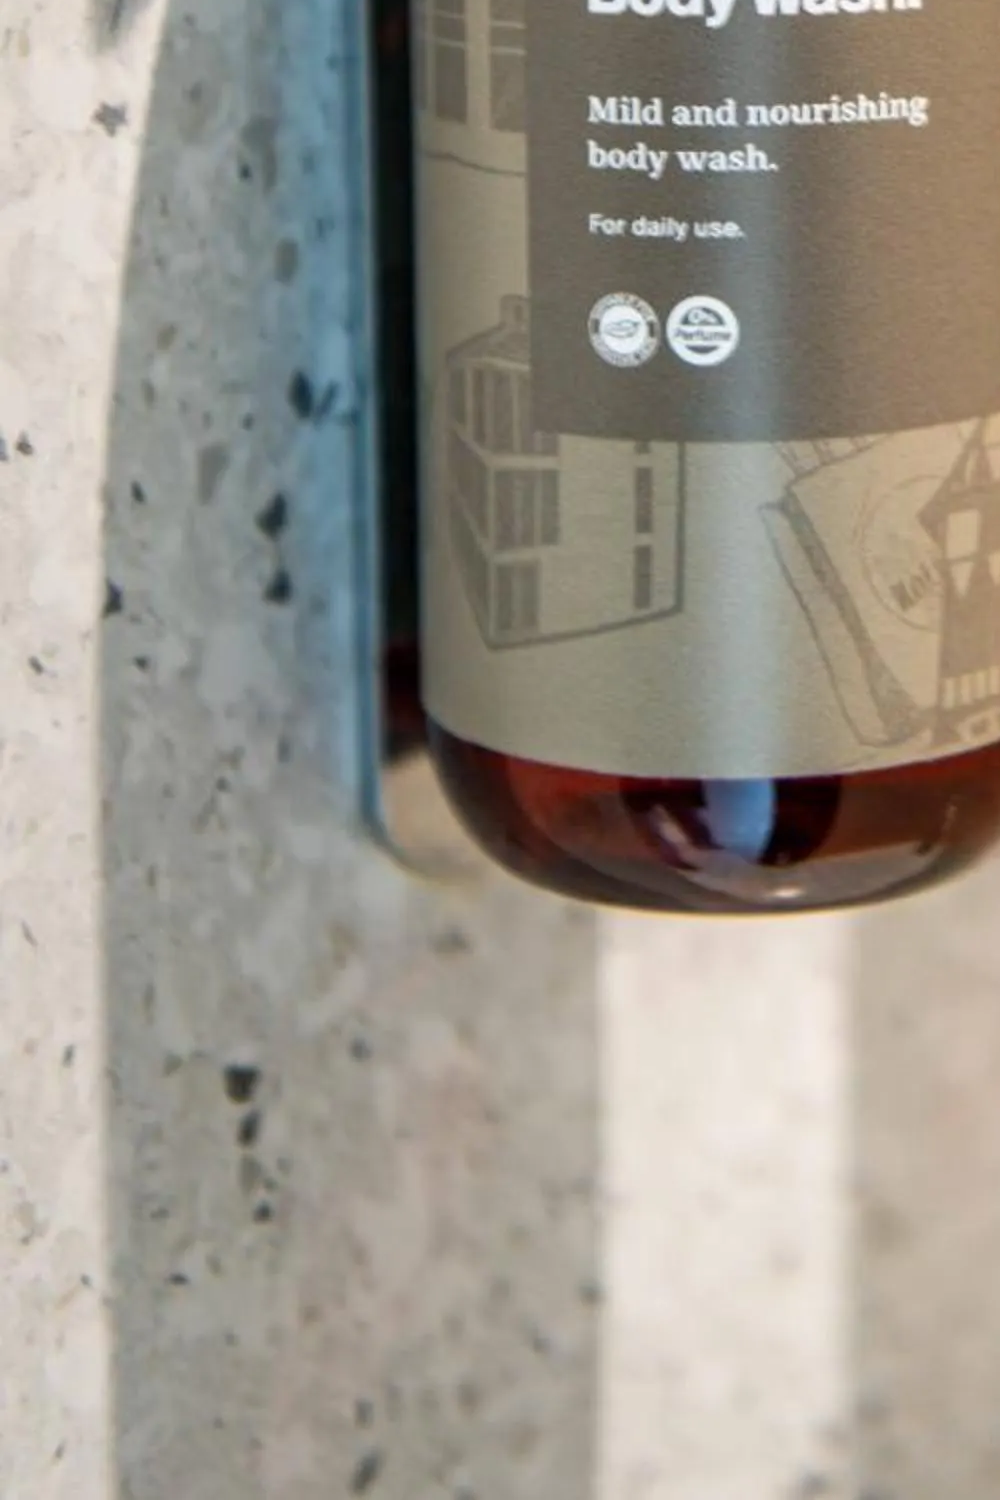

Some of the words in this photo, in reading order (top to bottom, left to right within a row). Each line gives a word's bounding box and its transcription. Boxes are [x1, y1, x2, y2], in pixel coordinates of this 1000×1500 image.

[588, 96, 663, 126] Mild
[672, 97, 739, 127] and
[746, 91, 929, 126] nourishing
[587, 140, 668, 180] body
[676, 143, 779, 172] wash.
[589, 213, 627, 236] For
[631, 215, 689, 242] daily
[693, 219, 745, 239] use.
